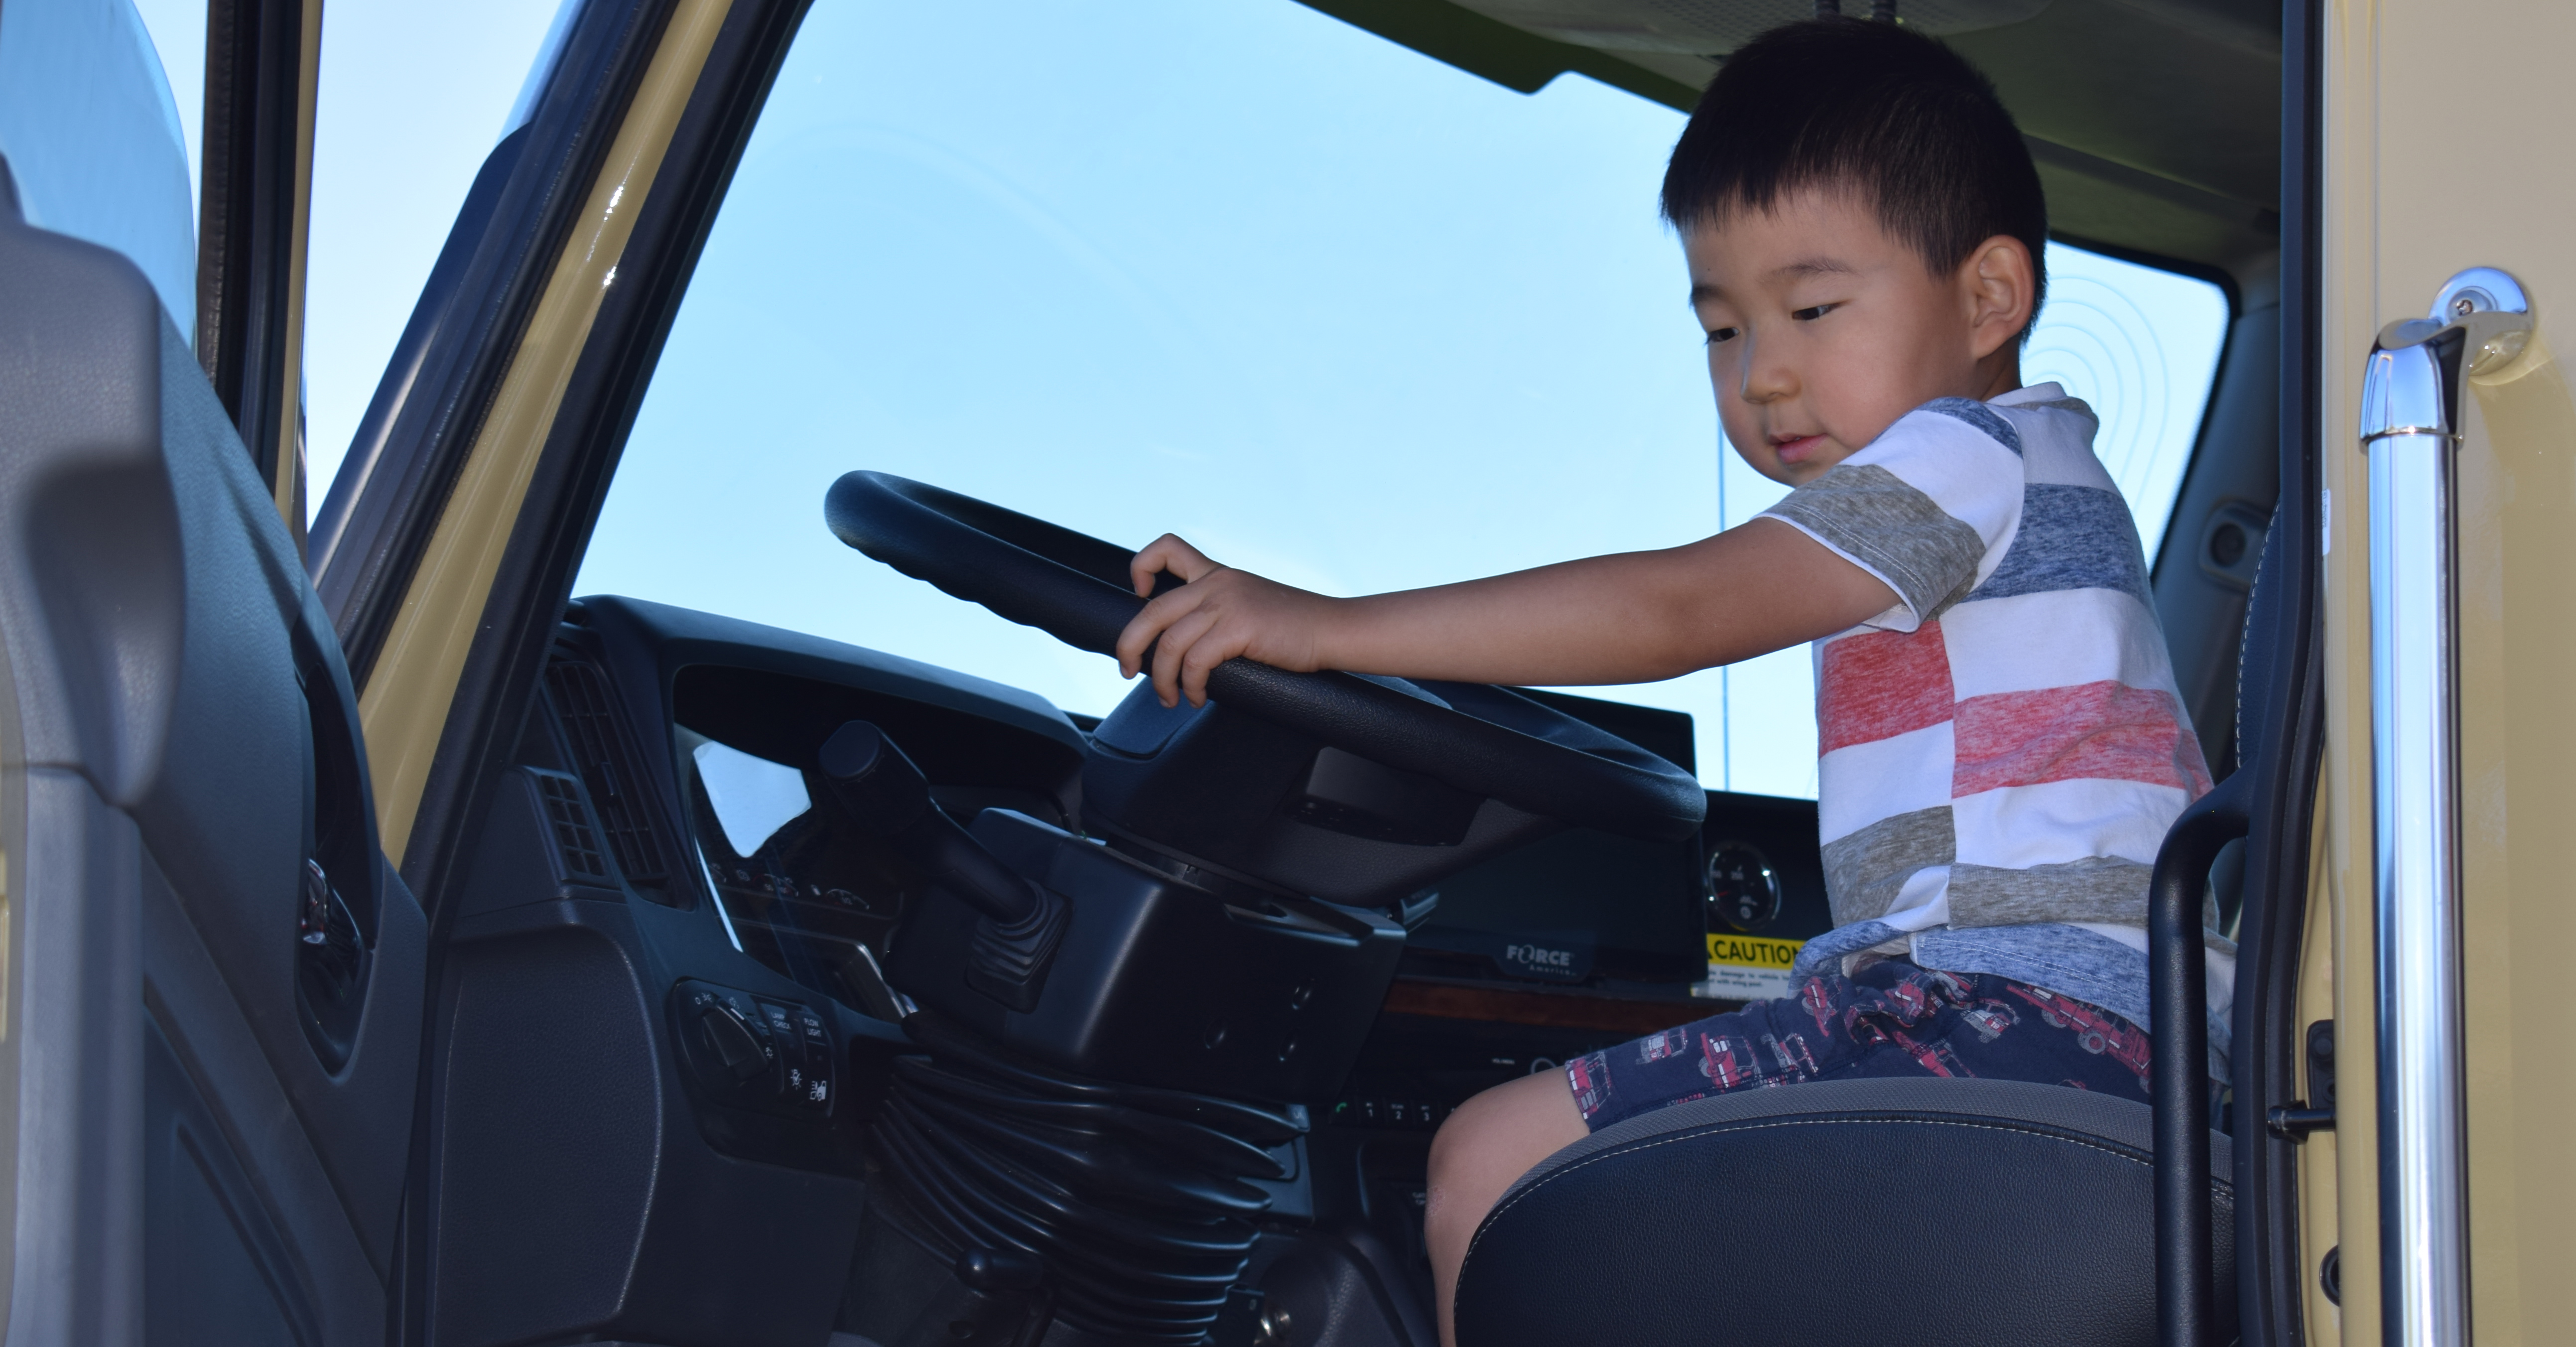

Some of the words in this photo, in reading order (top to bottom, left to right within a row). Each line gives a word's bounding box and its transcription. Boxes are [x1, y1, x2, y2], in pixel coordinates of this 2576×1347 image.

[1507, 944, 1570, 967] FORCE
[773, 1020, 791, 1030] CHECK
[804, 1018, 819, 1027] PLOW
[807, 1028, 821, 1038] LIGHT
[1368, 1109, 1373, 1117] 1
[1396, 1110, 1402, 1120] 2
[1424, 1112, 1430, 1121] 3
